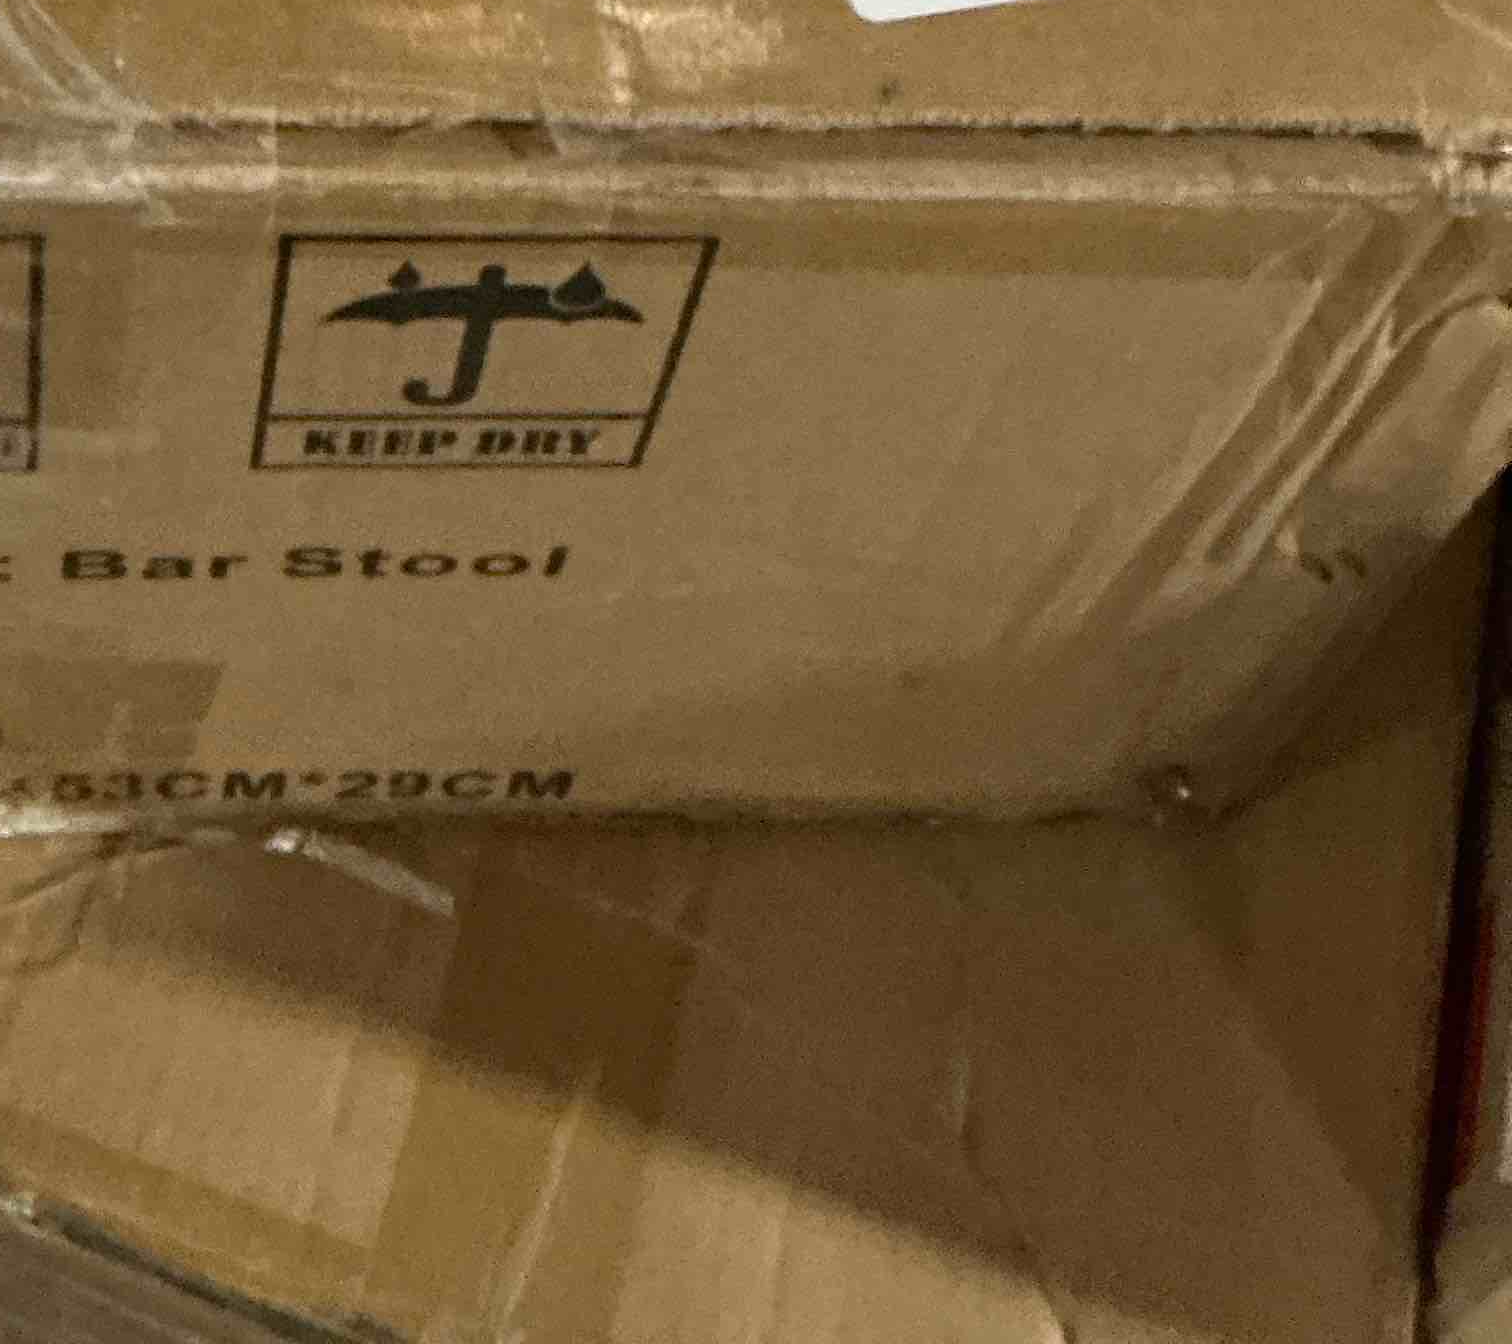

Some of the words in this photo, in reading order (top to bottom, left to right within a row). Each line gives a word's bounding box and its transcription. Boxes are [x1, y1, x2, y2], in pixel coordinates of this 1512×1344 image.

[303, 429, 457, 456] KEEP
[476, 429, 598, 456] DRY
[60, 548, 249, 582] Bar
[282, 546, 568, 579] Stool
